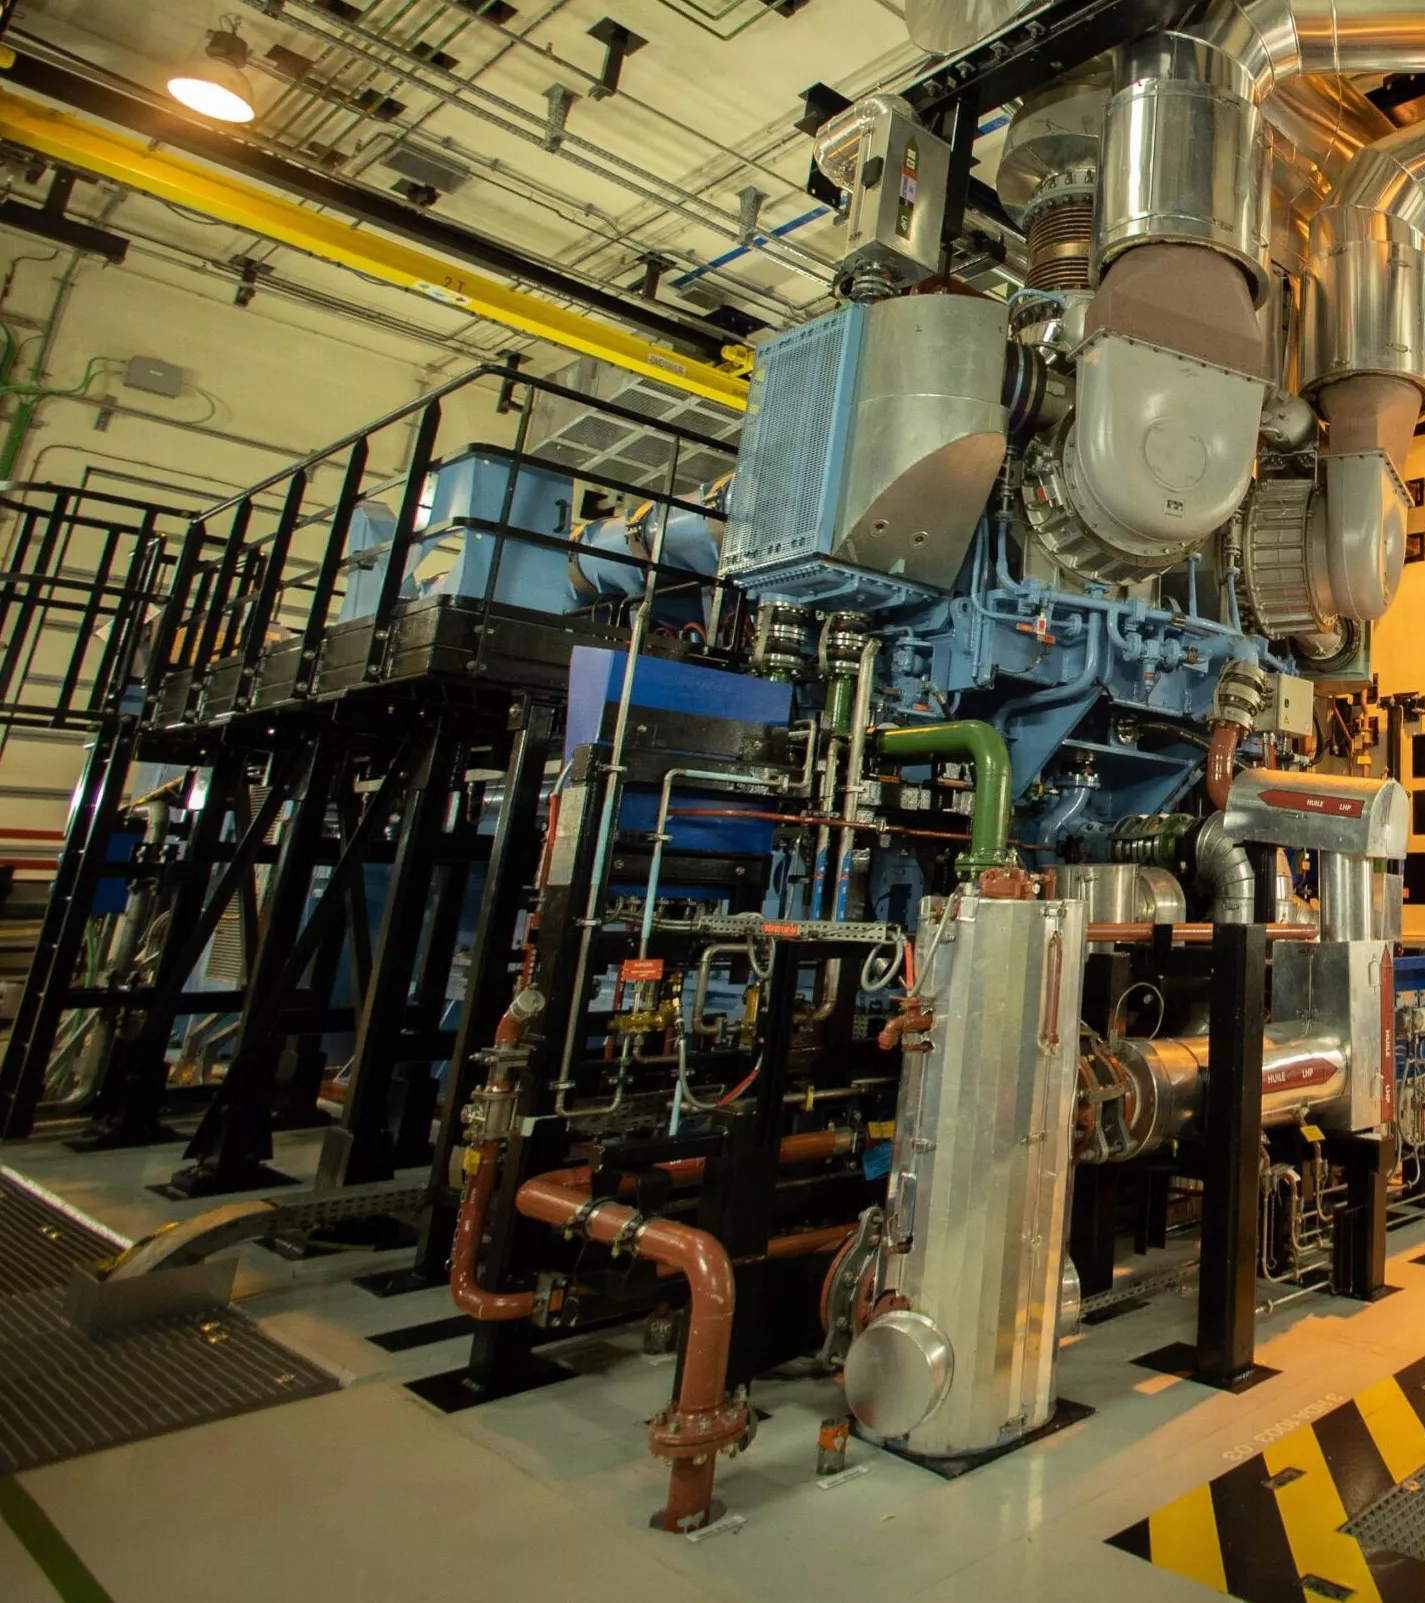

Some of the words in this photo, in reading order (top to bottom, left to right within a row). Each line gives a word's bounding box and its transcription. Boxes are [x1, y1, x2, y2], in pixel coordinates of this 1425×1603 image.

[1306, 799, 1324, 808] HUILE
[1339, 803, 1352, 811] LHP
[1267, 1071, 1286, 1084] HUILE
[1301, 1067, 1314, 1078] LHP
